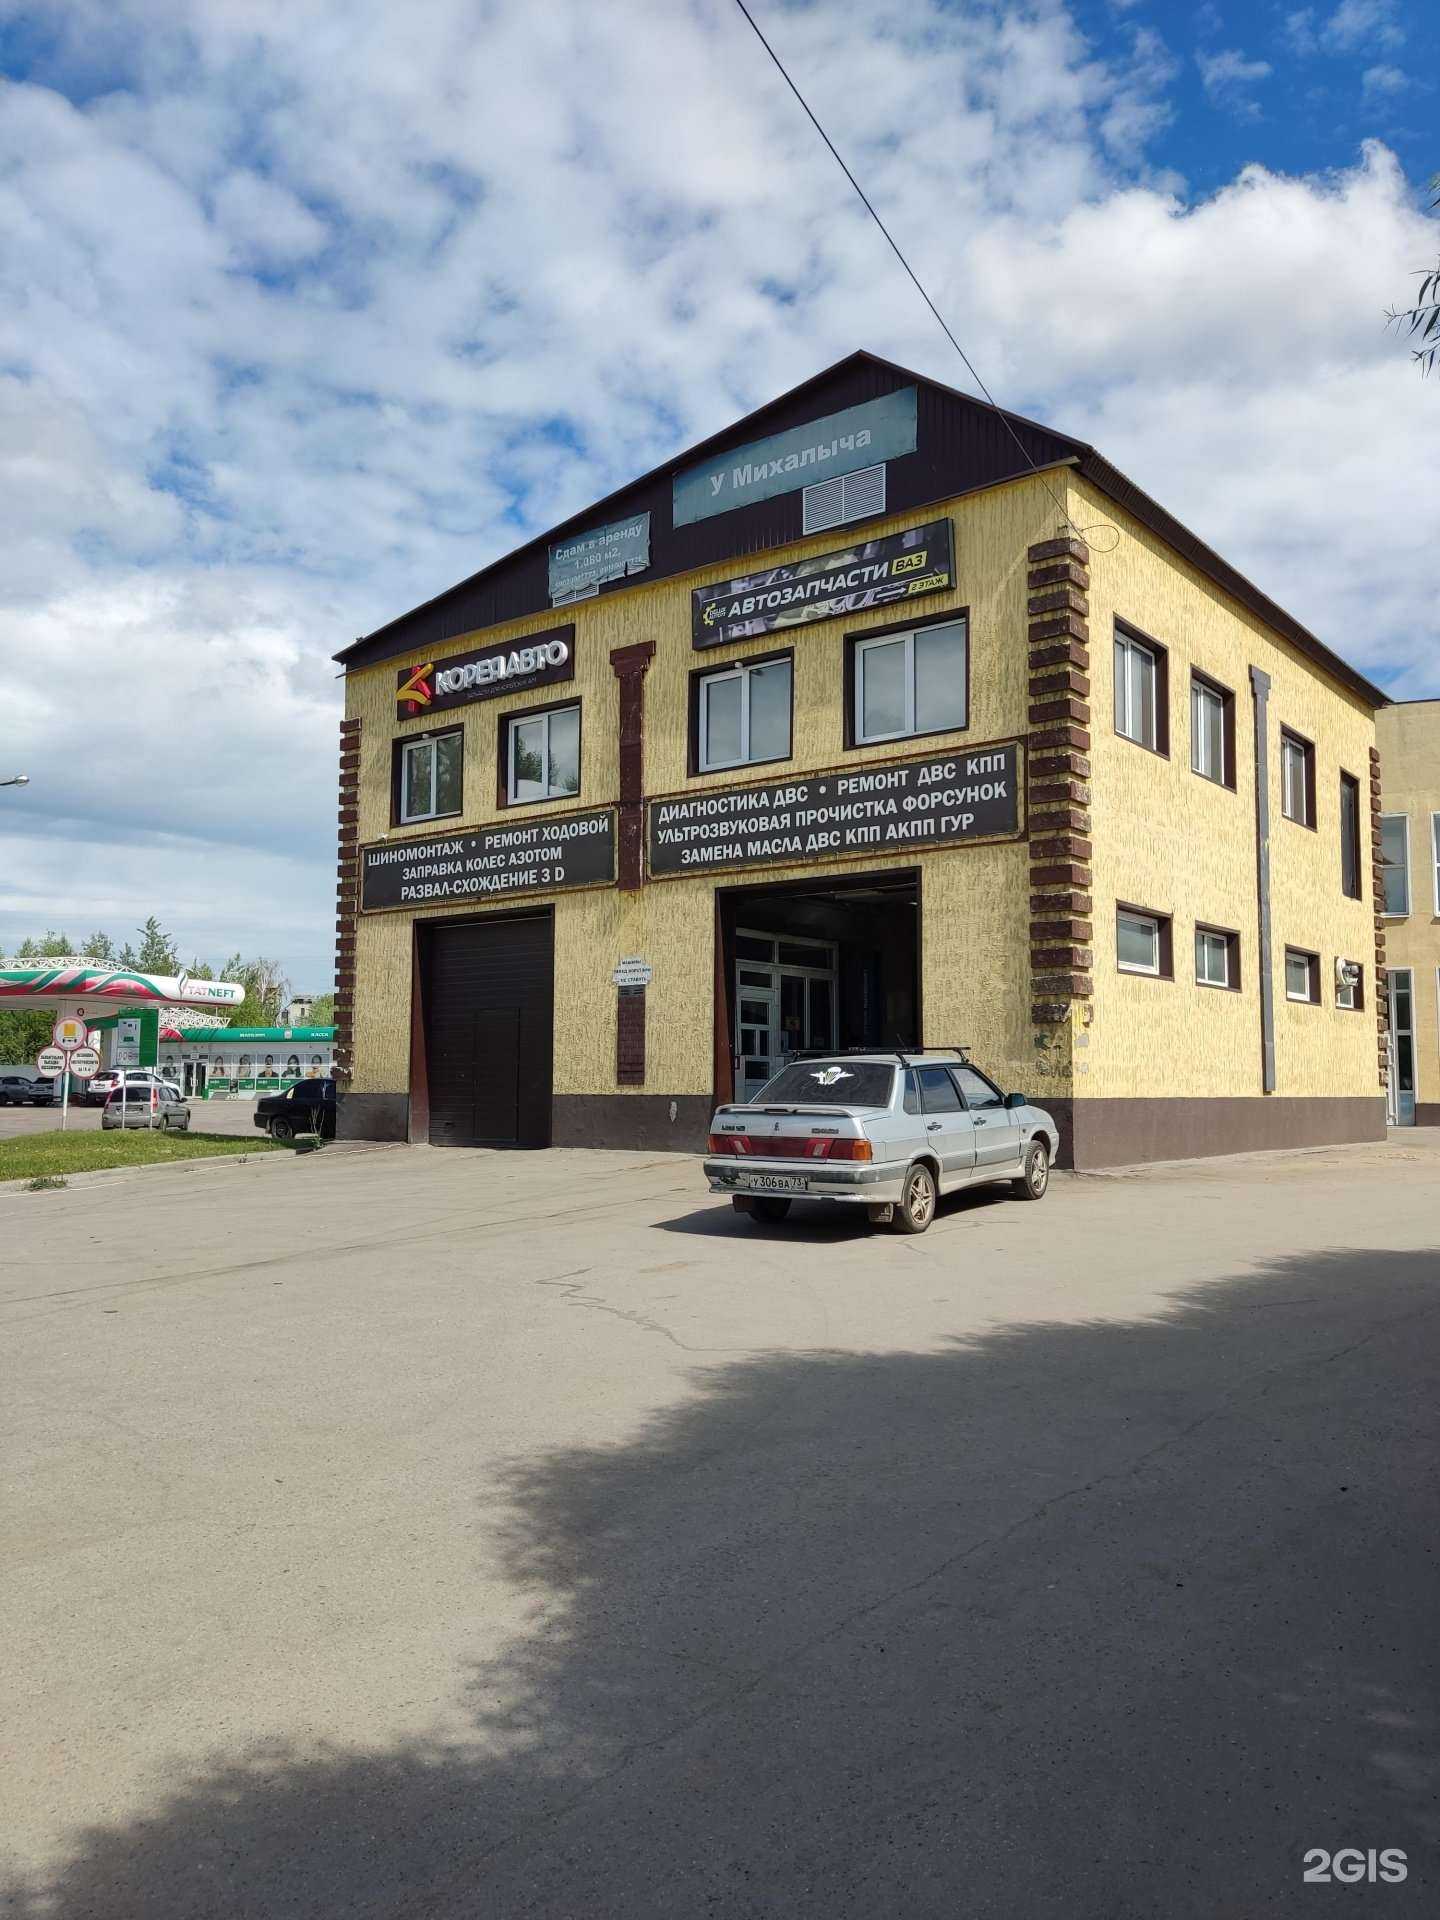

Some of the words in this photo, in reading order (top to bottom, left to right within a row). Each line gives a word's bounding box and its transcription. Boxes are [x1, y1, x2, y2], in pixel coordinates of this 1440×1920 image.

[733, 429, 871, 489] Михалыча
[555, 543, 585, 561] Сдам
[598, 524, 642, 546] аренду
[728, 562, 889, 618] АВТОЗАПЧАСТИ
[895, 555, 923, 571] ВАЗ
[919, 576, 944, 588] ЭТАЖ
[657, 813, 790, 845] УЛЬТРОЗВУКОВАЯ
[795, 800, 897, 828] ПРОЧИСТКА
[903, 781, 1007, 813] ФОРСУНОК
[658, 792, 769, 825] ДИАГНОСТИКА
[773, 785, 808, 809] ДВС
[837, 770, 909, 796] РЕМОНТ
[917, 763, 956, 787] ДВС
[966, 753, 1005, 776] КПП
[367, 840, 464, 867] ШИНОМОНТАЖ
[485, 828, 539, 850] РЕМОНТ
[542, 814, 609, 842] ХОДОВОЙ
[402, 860, 463, 880] ЗАПРАВКА
[466, 855, 506, 873] КОЛЕС
[508, 846, 562, 867] АЗОТОМ
[681, 842, 743, 865] ЗАМЕНА
[747, 837, 802, 860] МАСЛА
[806, 831, 841, 852] ДВС
[845, 823, 881, 846] КПП
[886, 818, 935, 840] АКПП
[940, 812, 975, 833] ГУР
[401, 869, 538, 900] РАЗВАЛ-СХОЖДЕНИЕ
[541, 869, 551, 883] 3
[554, 866, 564, 882] D
[188, 985, 235, 998] TATNEFT
